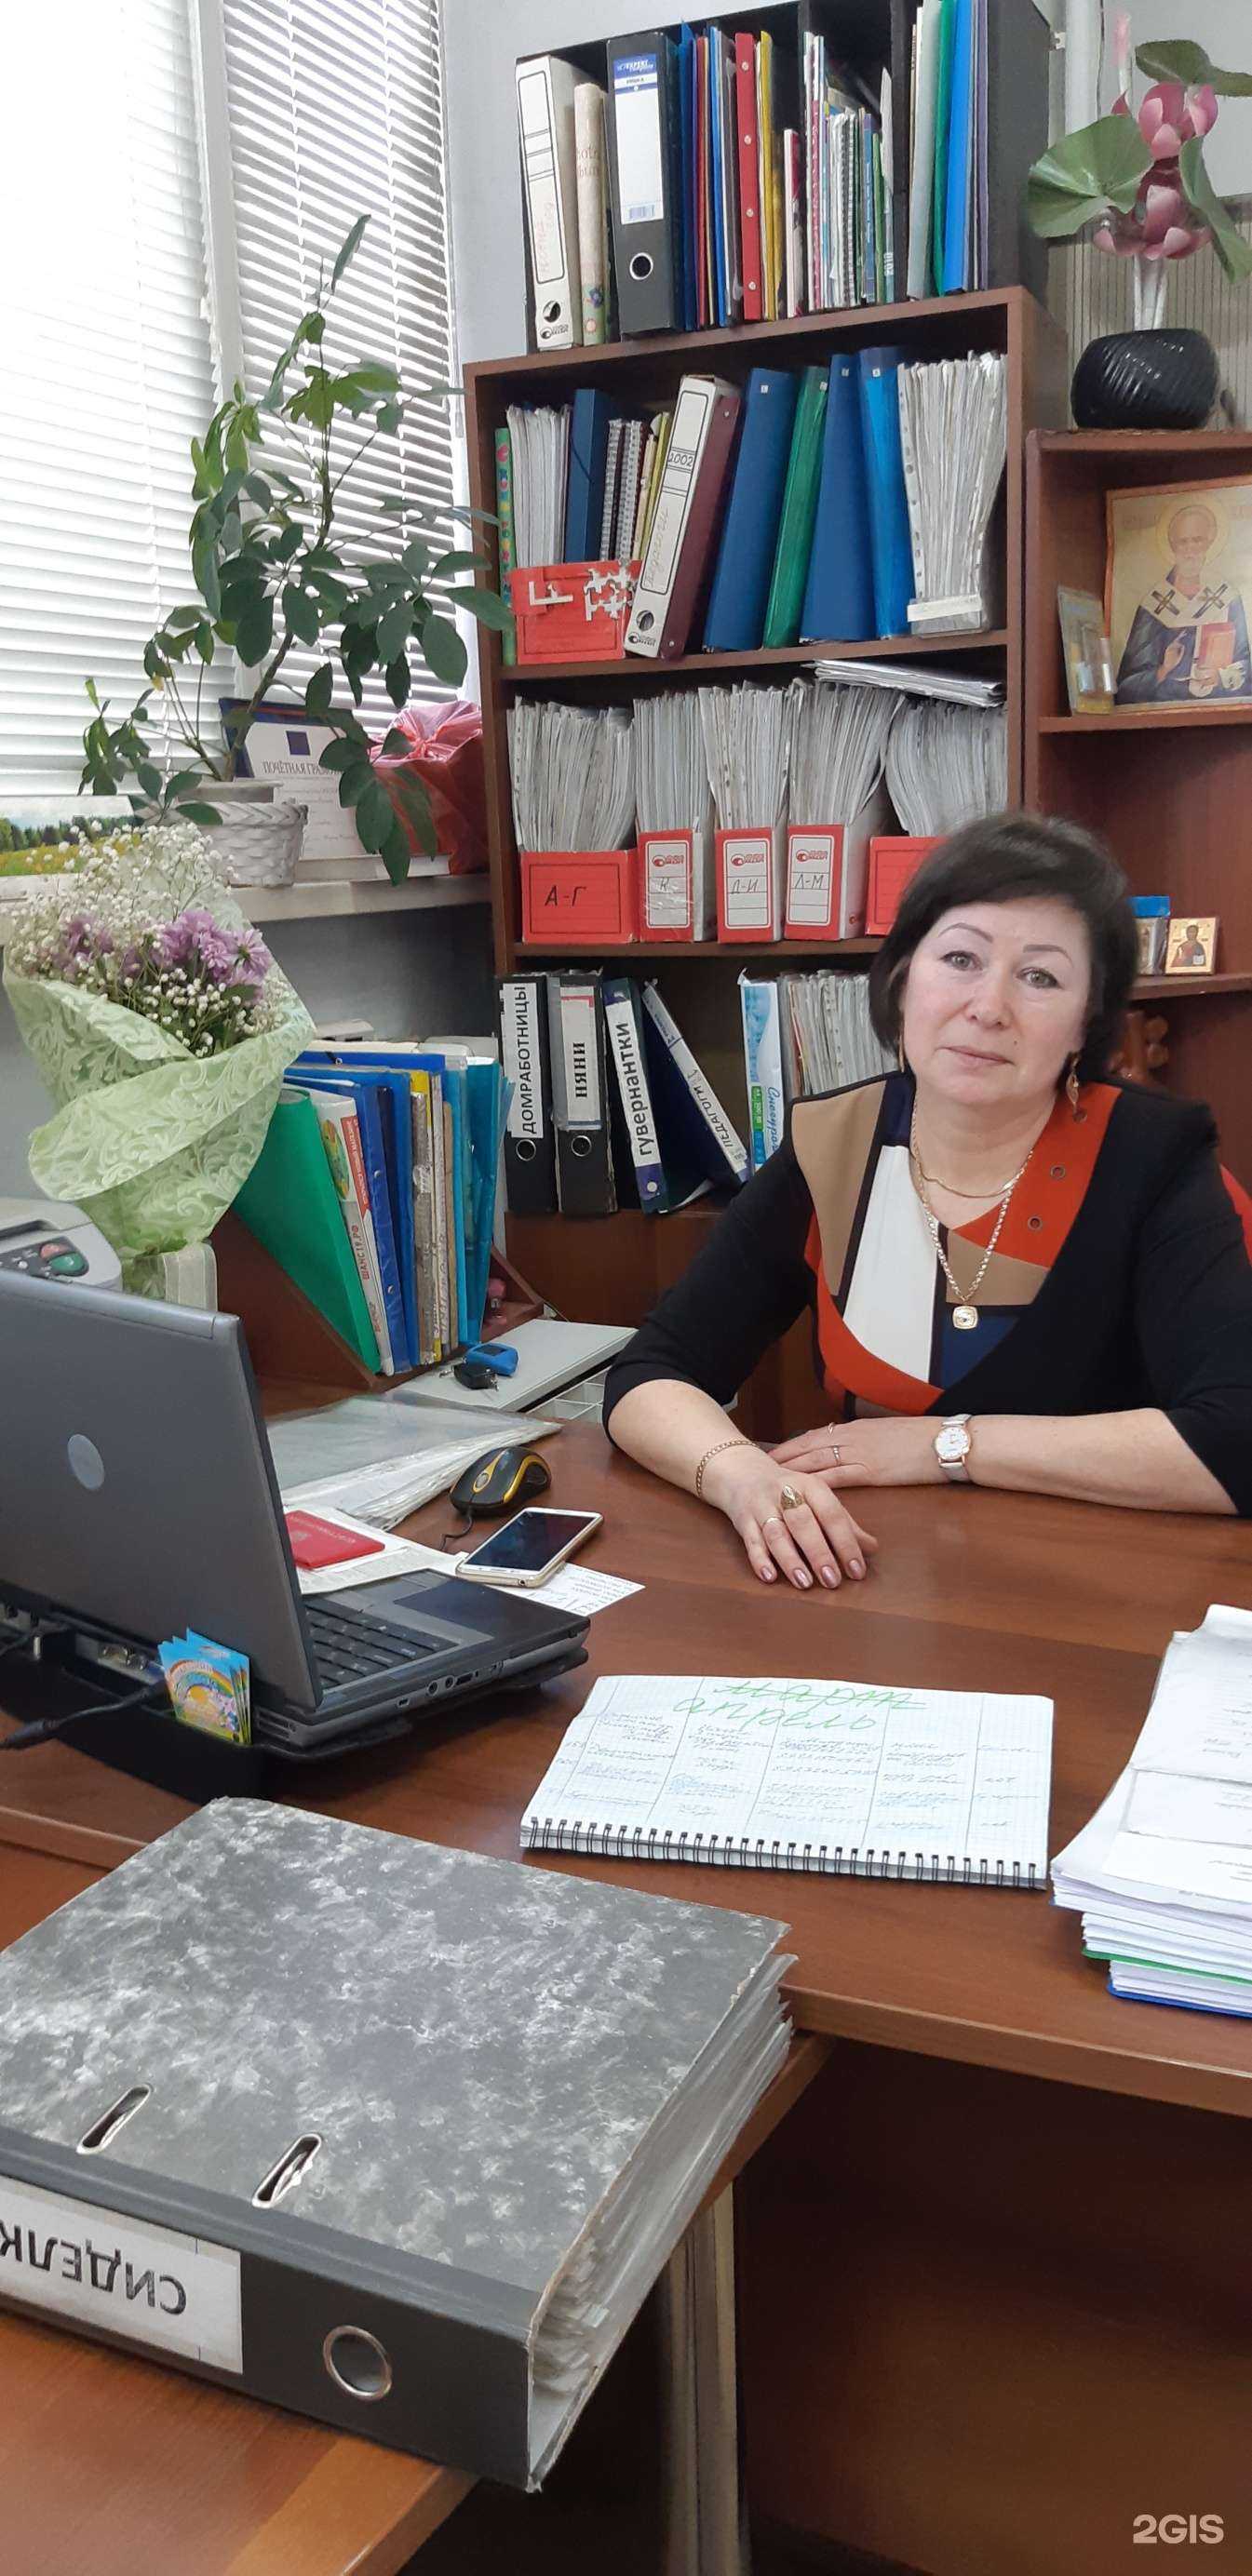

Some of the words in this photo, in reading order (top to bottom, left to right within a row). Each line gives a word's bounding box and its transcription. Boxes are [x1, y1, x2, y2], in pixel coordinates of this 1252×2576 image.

[883, 251, 894, 276] 2010
[667, 452, 694, 467] 2002
[544, 884, 587, 907] А-Г
[515, 986, 538, 1135] ДОМРАБОТНИЦЫ
[572, 1041, 589, 1099] НЯНИ
[615, 1023, 653, 1157] гувернантки
[693, 1084, 734, 1148] ПЕДАГОГИ
[673, 1697, 876, 1732] апрель
